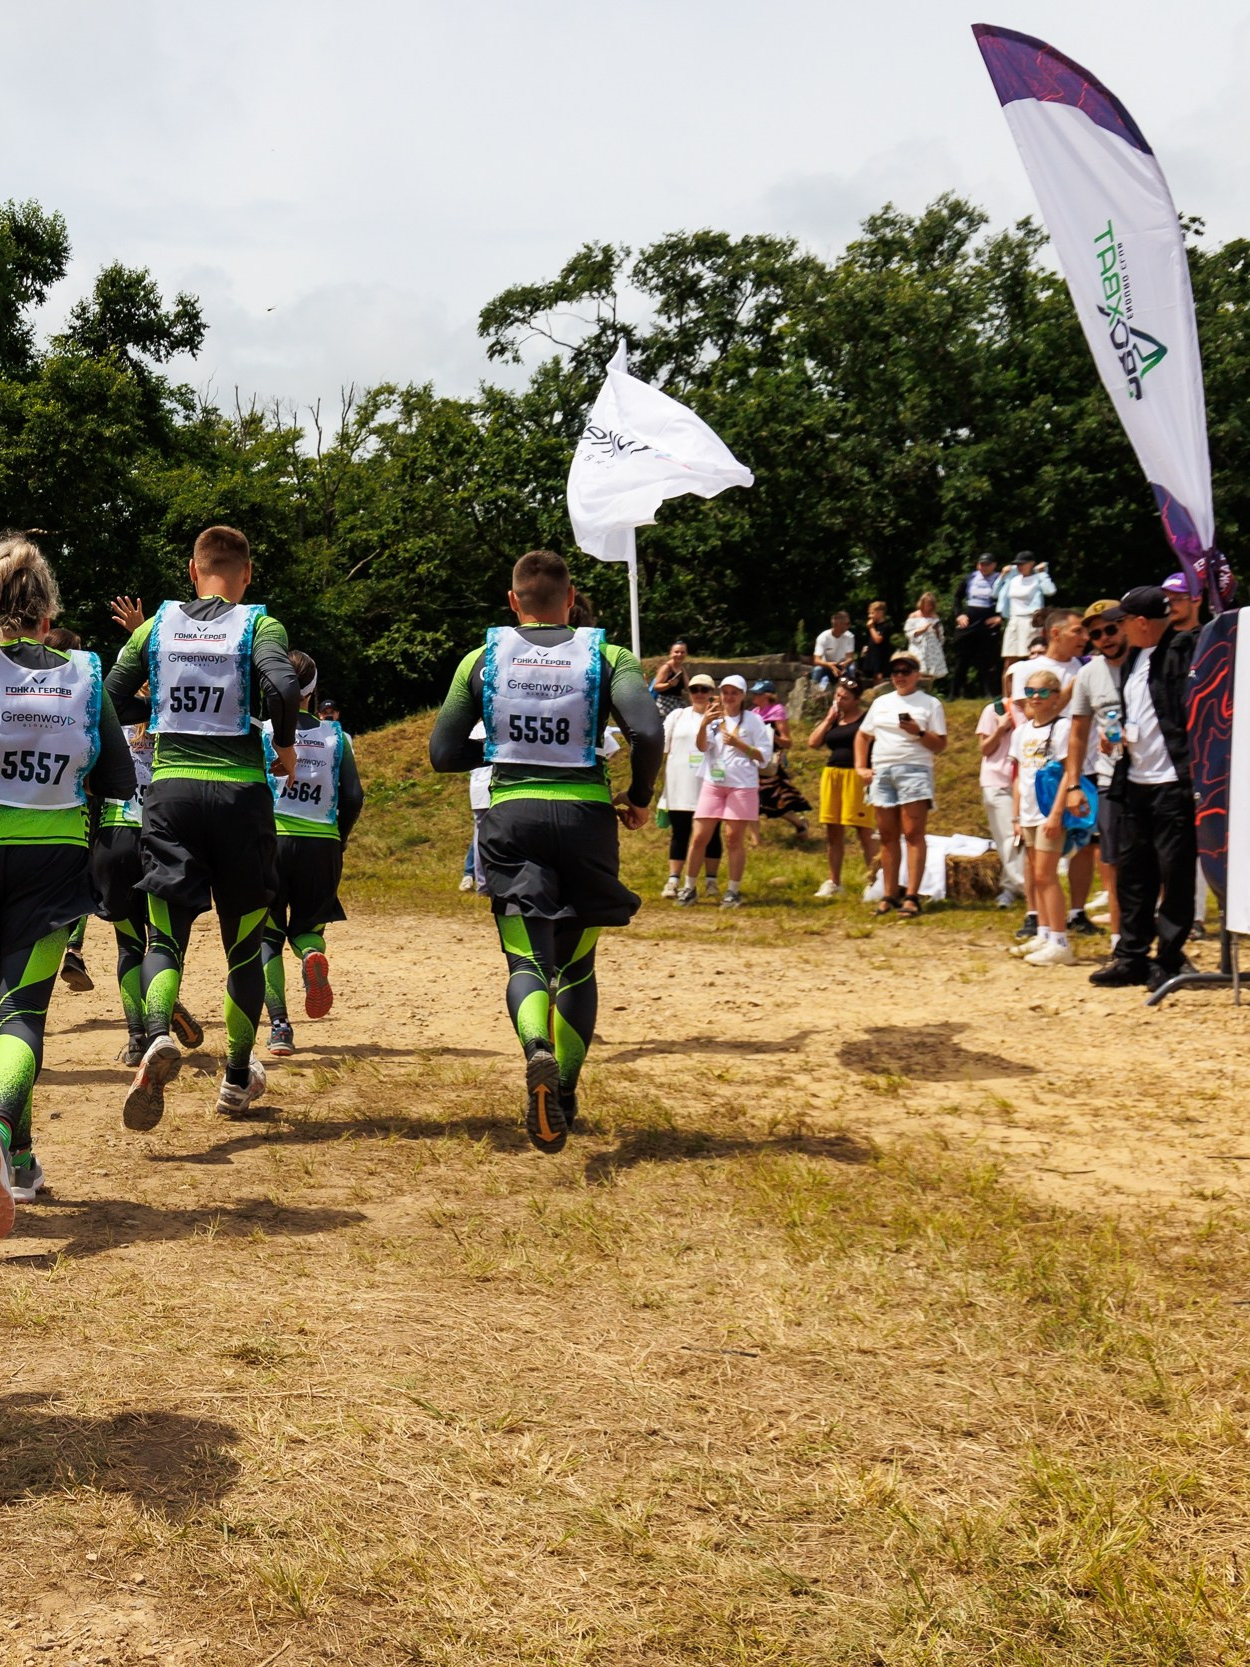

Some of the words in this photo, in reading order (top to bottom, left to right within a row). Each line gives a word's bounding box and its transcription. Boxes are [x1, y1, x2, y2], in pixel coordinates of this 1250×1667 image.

[168, 653, 220, 664] Greenway
[5, 686, 36, 694] ГОНКА
[38, 687, 72, 696] ГЕРОЕВ
[507, 679, 565, 695] Greenway
[170, 686, 225, 714] 5577
[1, 710, 67, 727] Greenway
[509, 714, 570, 745] 5558
[1, 750, 71, 785] 5557
